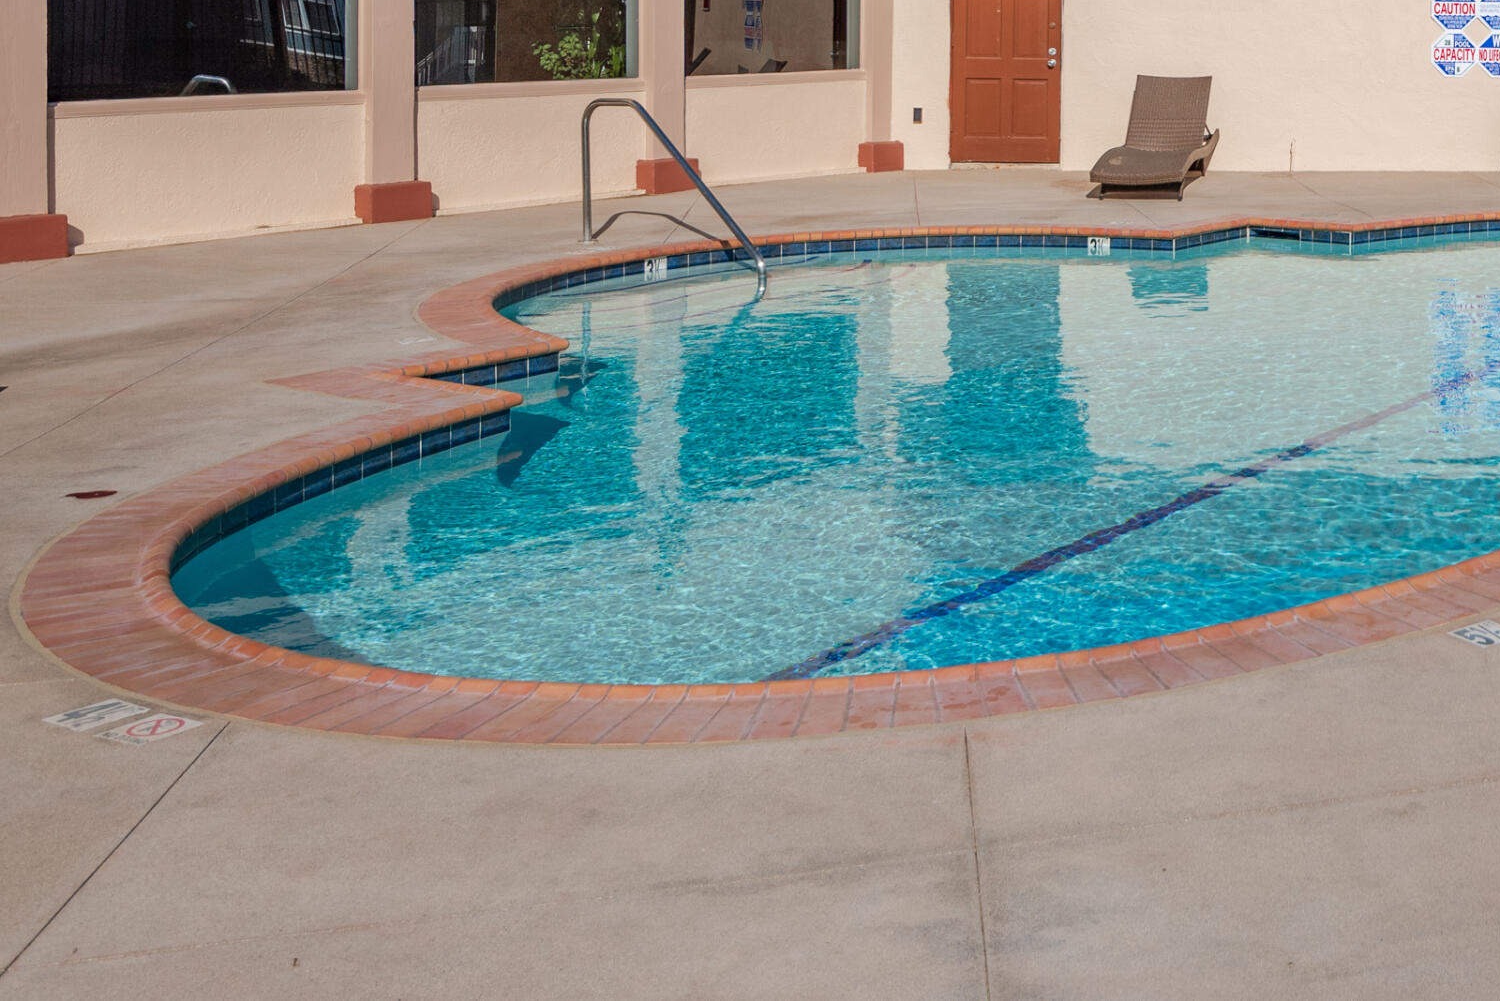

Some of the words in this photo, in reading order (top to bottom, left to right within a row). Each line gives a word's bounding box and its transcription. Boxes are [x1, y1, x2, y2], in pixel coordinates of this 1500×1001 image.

[1433, 2, 1476, 15] CAUTION
[1433, 48, 1476, 61] CAPACITY
[1479, 49, 1488, 61] NO
